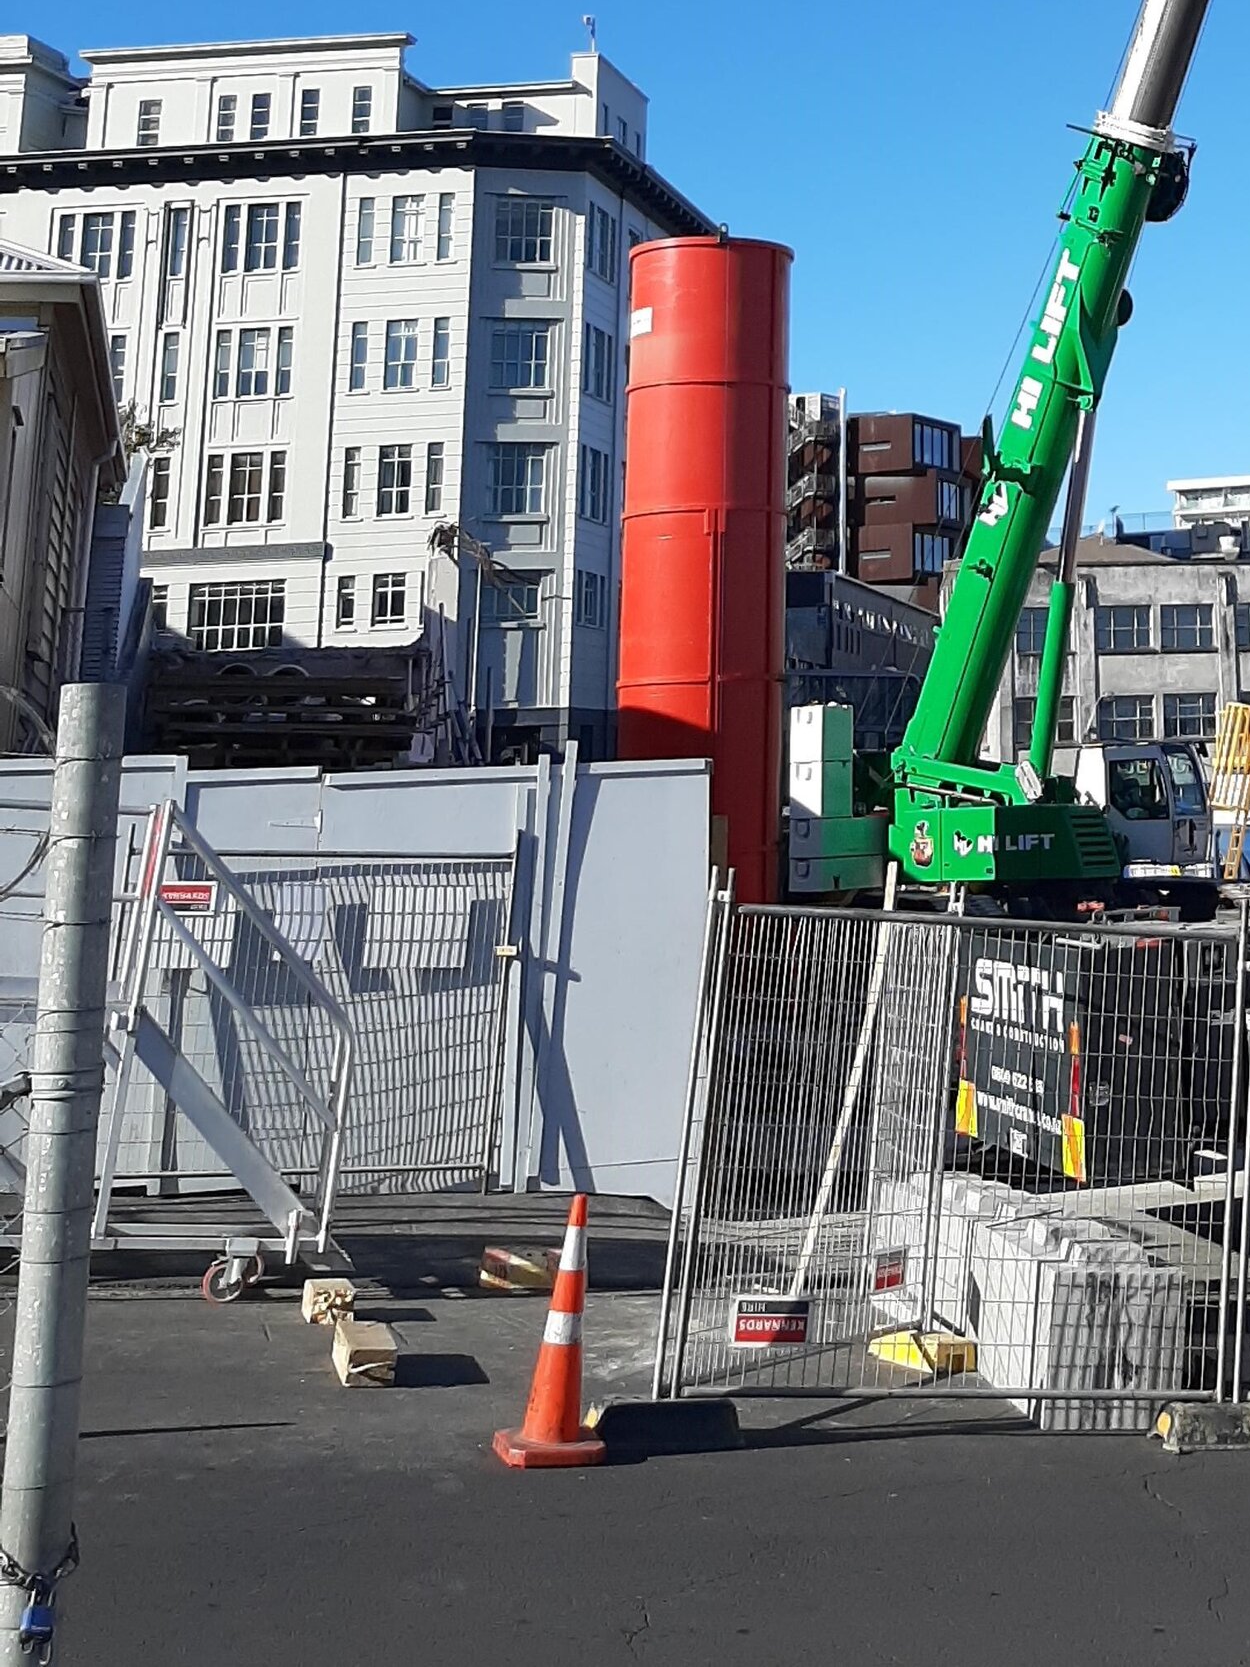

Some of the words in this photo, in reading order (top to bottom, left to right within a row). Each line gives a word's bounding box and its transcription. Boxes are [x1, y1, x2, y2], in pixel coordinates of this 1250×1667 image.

[1011, 376, 1043, 429] HI
[1031, 248, 1080, 363] LIFT
[977, 835, 999, 853] HI
[1006, 834, 1055, 851] LIFT
[971, 958, 1063, 1032] SMITH
